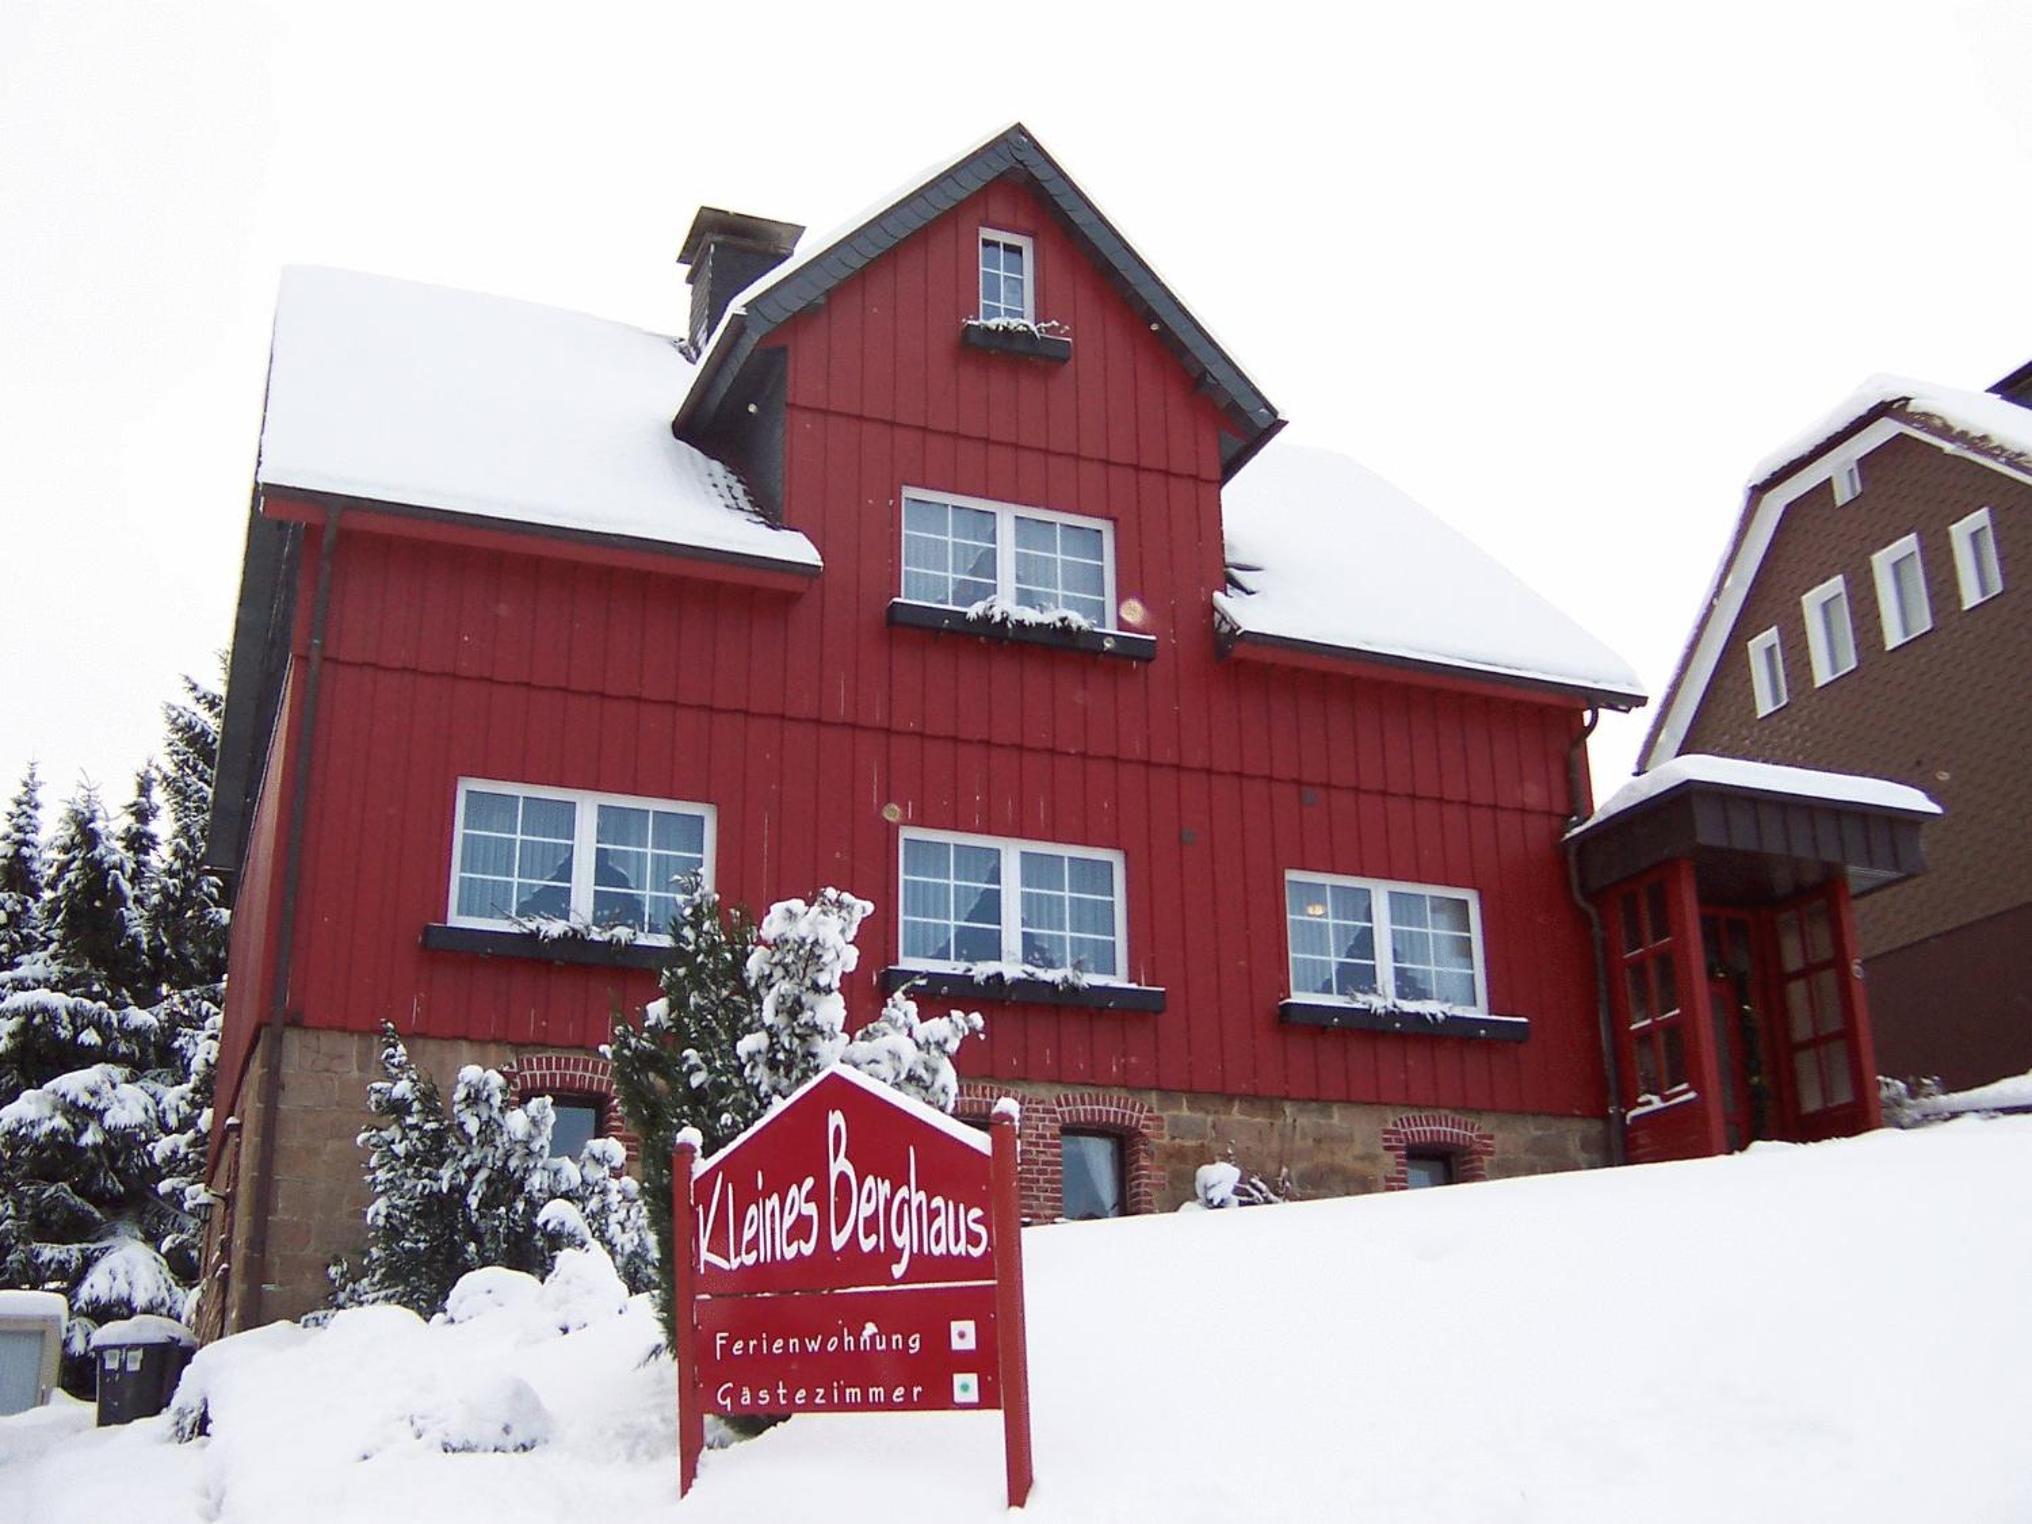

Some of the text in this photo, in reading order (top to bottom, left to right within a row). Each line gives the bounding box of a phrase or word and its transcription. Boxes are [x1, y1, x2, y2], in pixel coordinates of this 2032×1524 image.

[698, 1109, 988, 1279] Kleines Berghaus
[715, 1327, 921, 1361] Ferienwohnung
[716, 1381, 922, 1411] Gästezimmer
